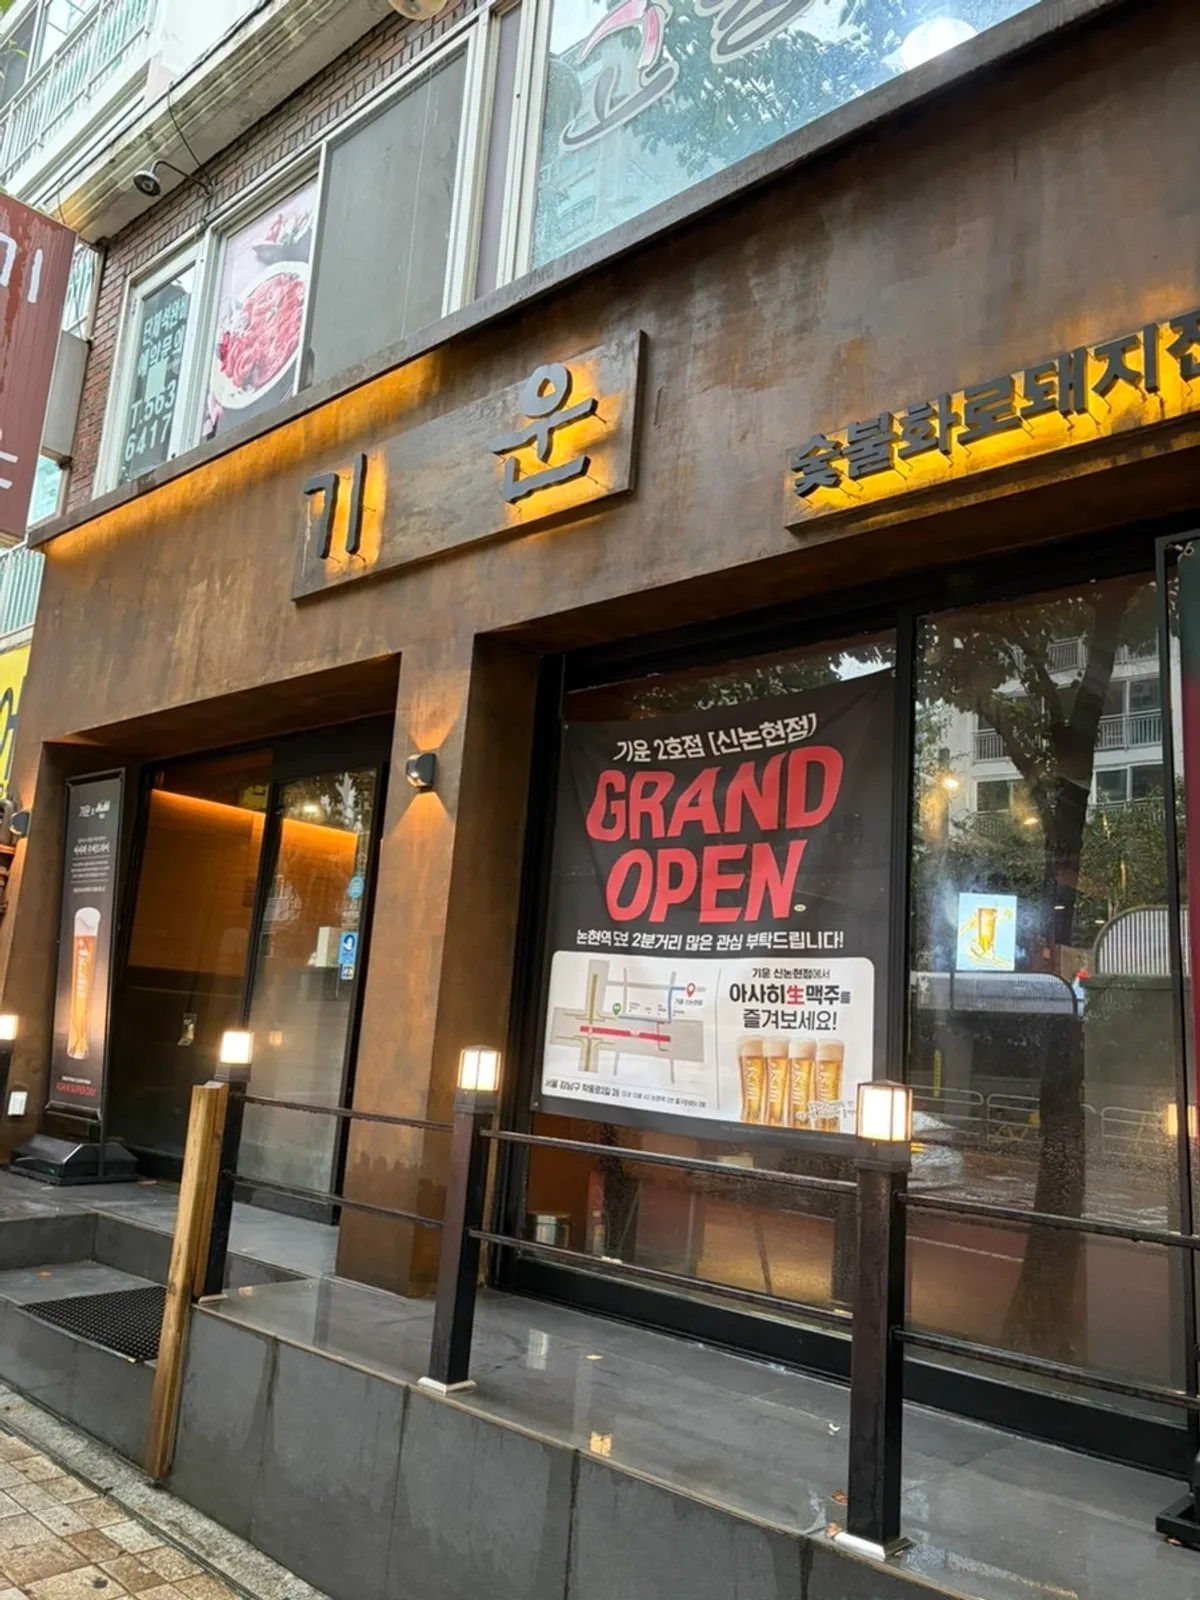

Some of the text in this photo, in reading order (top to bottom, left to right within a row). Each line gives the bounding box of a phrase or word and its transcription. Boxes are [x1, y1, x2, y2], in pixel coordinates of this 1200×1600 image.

[131, 379, 176, 430] T.563
[124, 411, 171, 462] 6417
[613, 740, 652, 763] 기운
[654, 734, 706, 761] 2호점
[586, 745, 844, 842] GRAND
[605, 838, 810, 924] OPEN
[576, 928, 612, 947] 논현역
[632, 931, 683, 951] 2분거리
[685, 933, 713, 953] 많은
[715, 932, 744, 952] 관심
[745, 930, 845, 951] 부탁드립니다!
[751, 967, 831, 980] 기운 신논현점에서
[729, 982, 852, 1006] 아사히生맥주를
[742, 1008, 837, 1031] 즐겨보세요!
